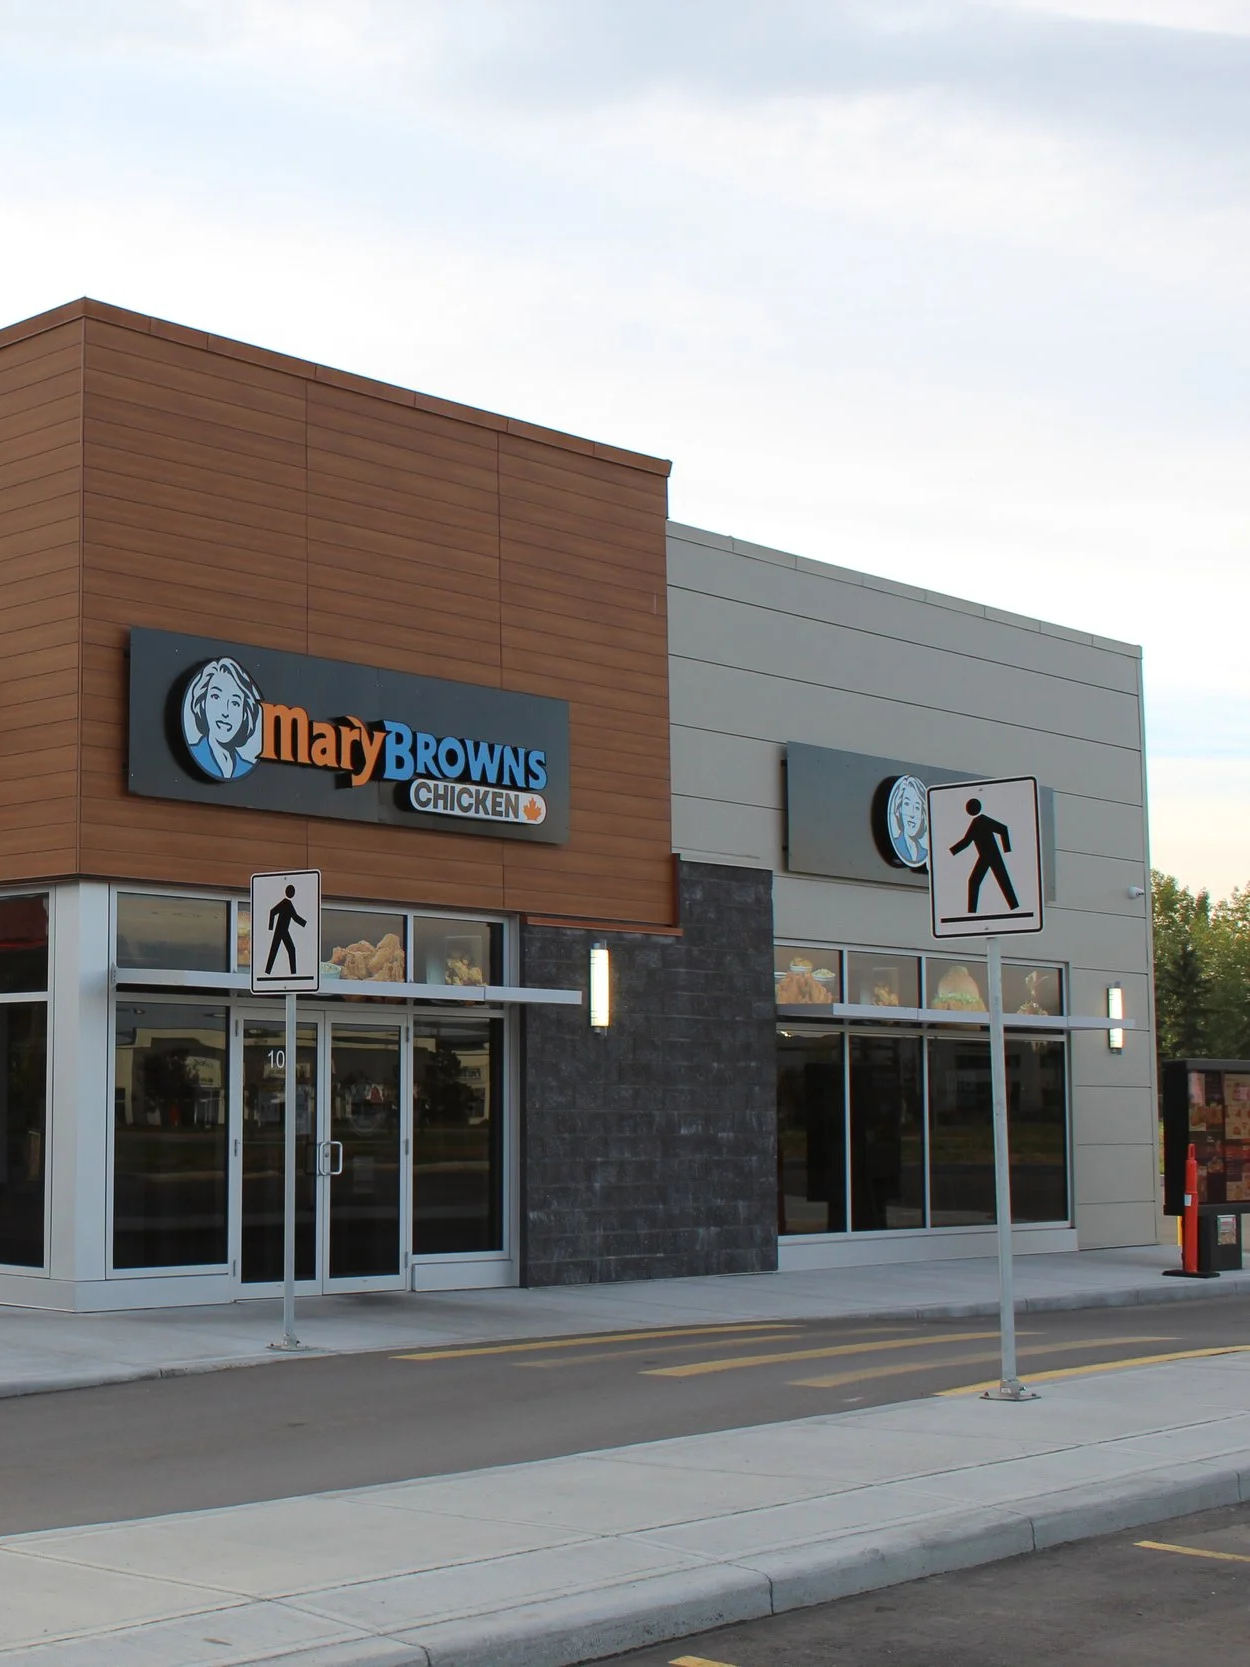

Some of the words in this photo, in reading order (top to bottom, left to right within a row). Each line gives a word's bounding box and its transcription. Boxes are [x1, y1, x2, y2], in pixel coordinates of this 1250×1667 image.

[258, 701, 387, 787] mary
[384, 720, 548, 790] BROWNS
[413, 781, 520, 819] CHICKEN
